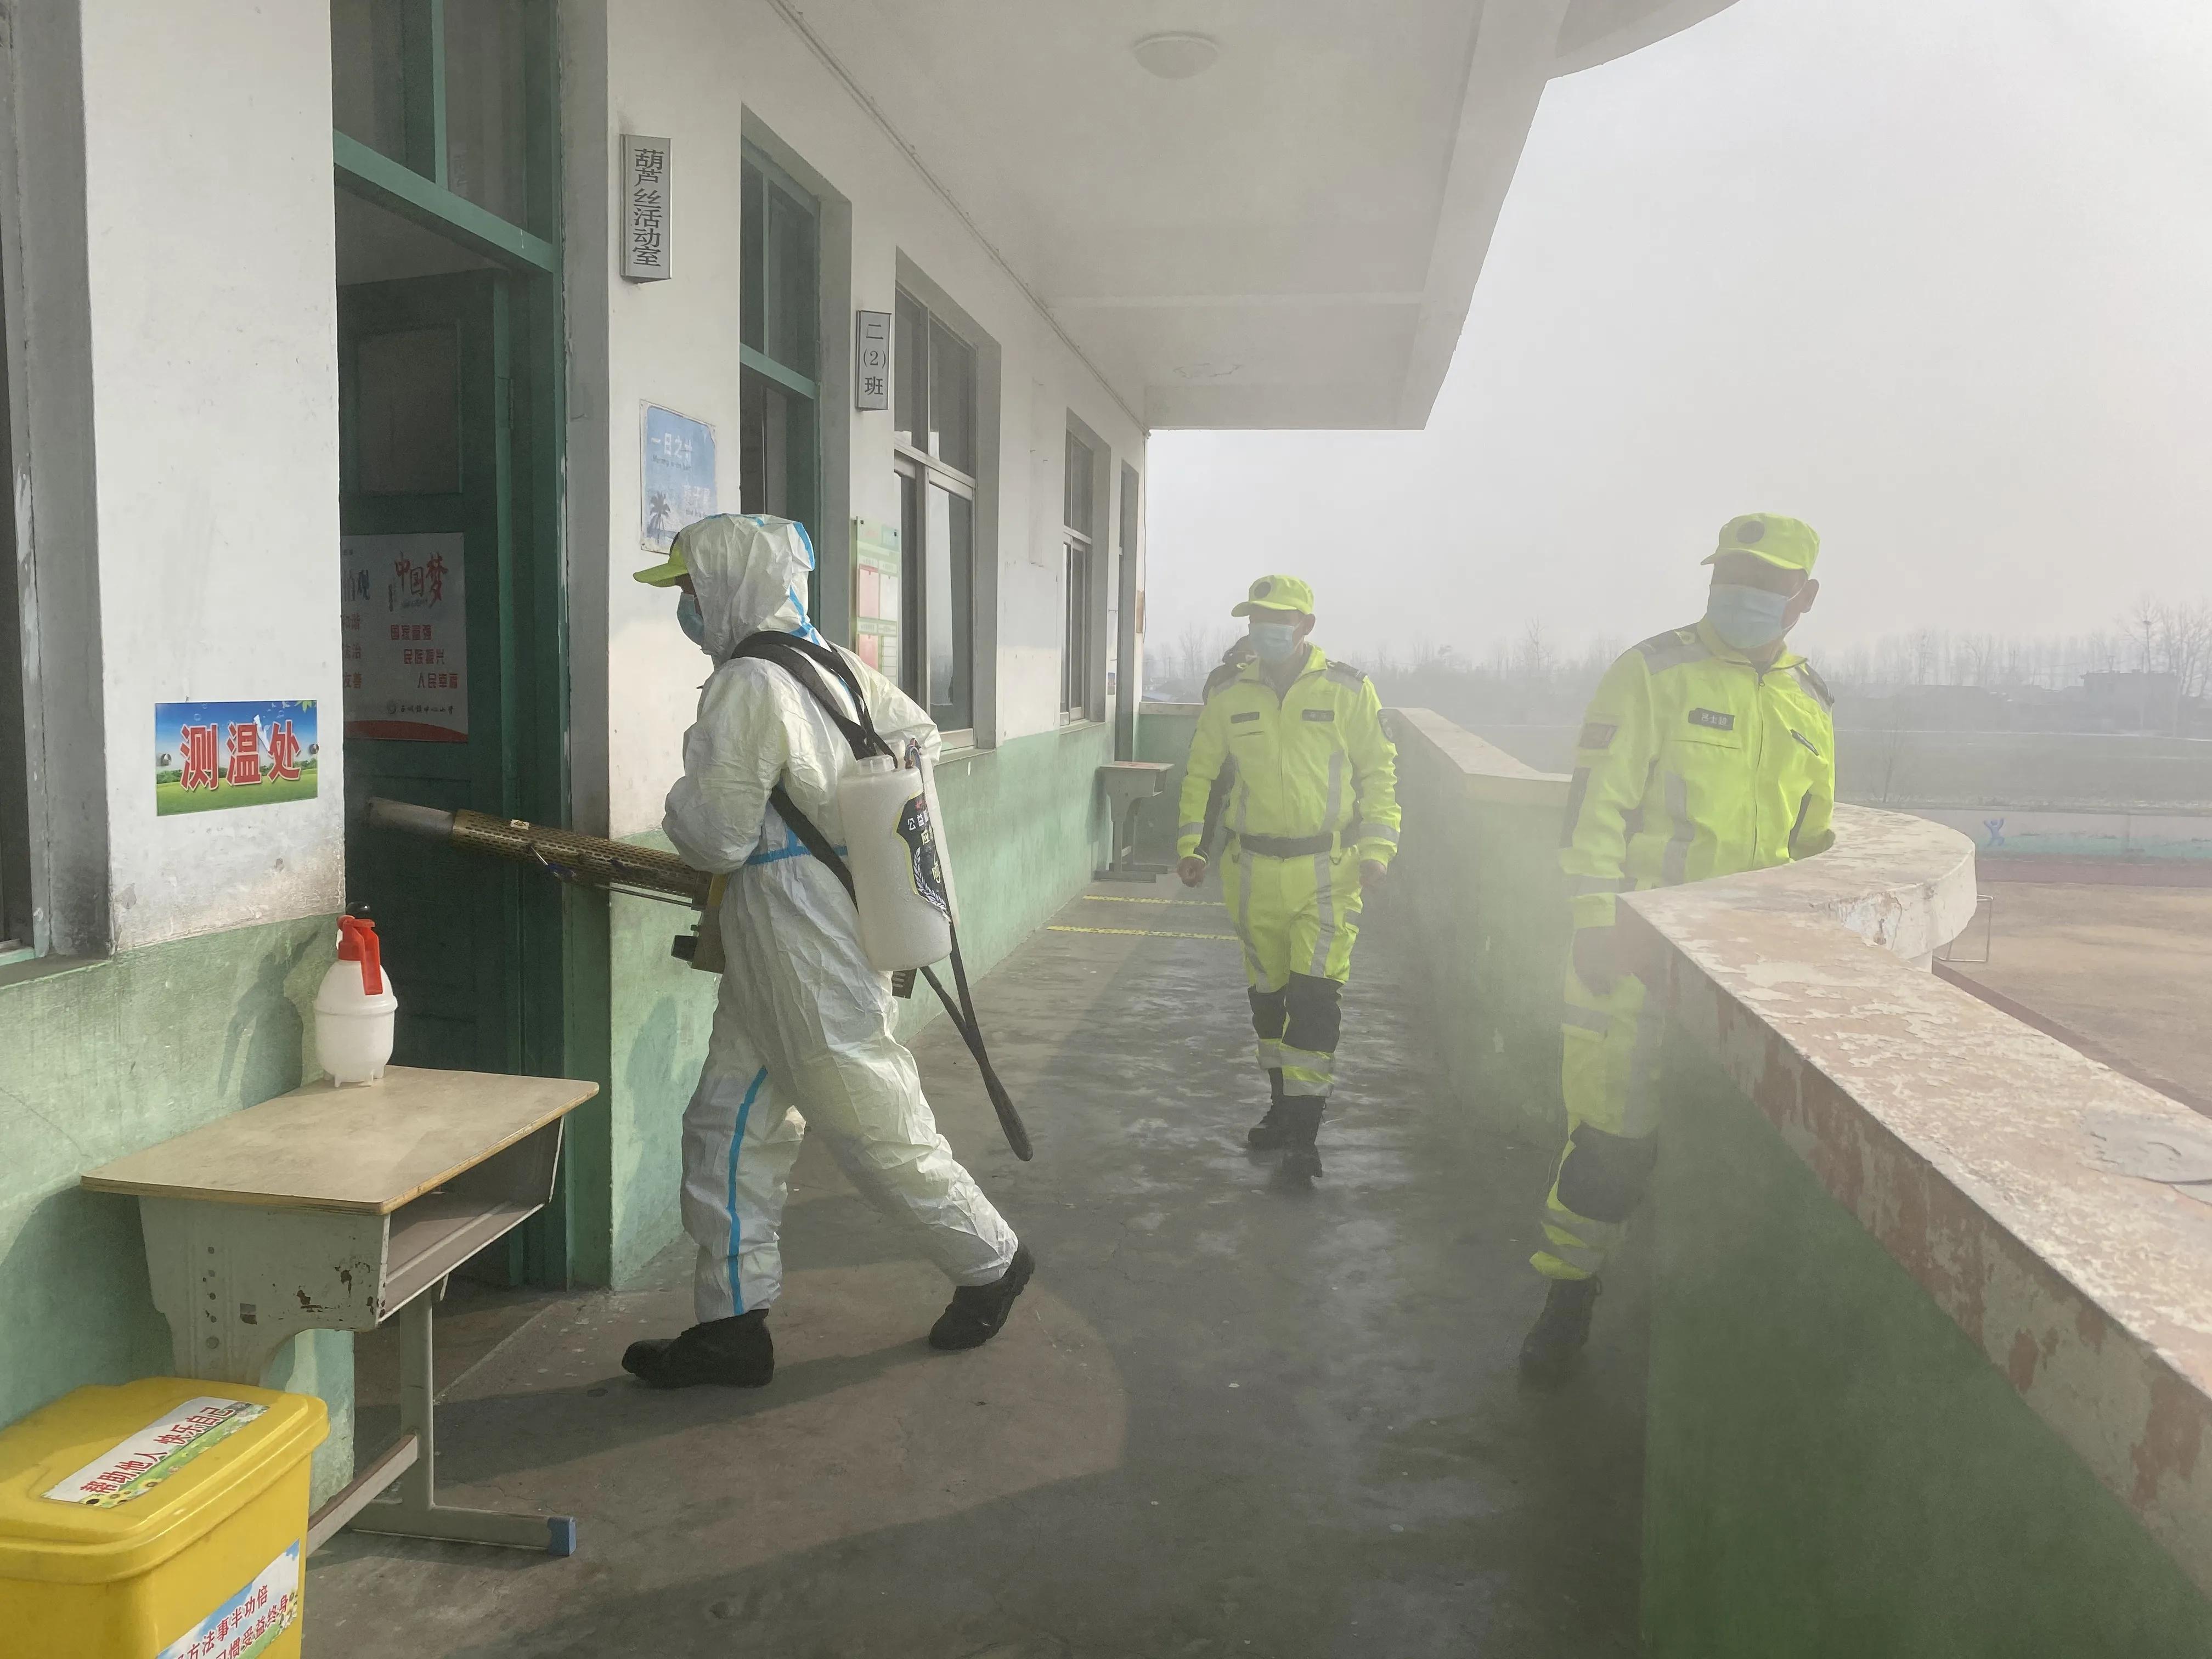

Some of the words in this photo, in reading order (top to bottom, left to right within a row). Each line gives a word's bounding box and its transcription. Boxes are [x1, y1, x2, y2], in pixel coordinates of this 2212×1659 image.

[633, 149, 663, 267] 葫芦丝活动室
[394, 551, 449, 608] 中国梦
[403, 648, 444, 665] 民族振兴
[417, 672, 458, 689] 人民幸福
[179, 720, 301, 791] 测温处
[80, 1452, 168, 1493] 帮助他人
[153, 1407, 235, 1445] 快乐自己
